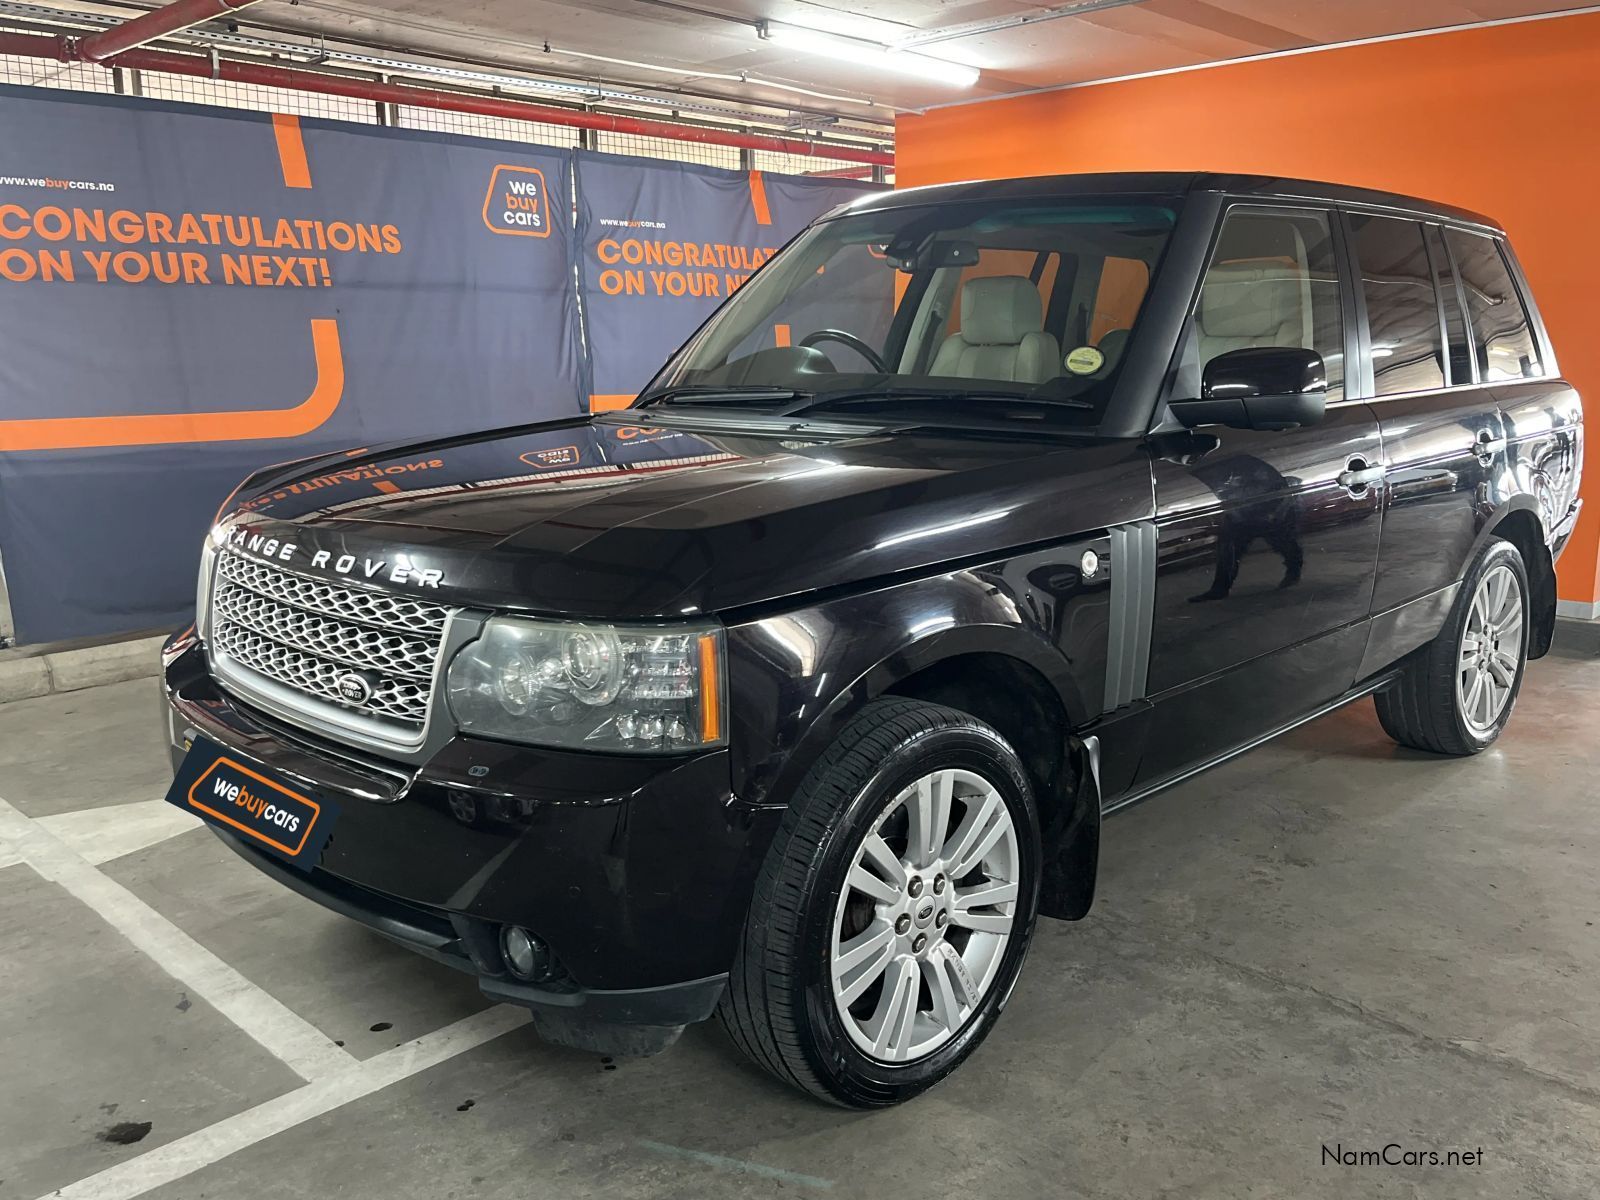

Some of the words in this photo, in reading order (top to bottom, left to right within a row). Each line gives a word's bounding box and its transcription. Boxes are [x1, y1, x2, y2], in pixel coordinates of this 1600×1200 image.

[505, 192, 537, 213] buy
[508, 180, 537, 196] we
[0, 204, 402, 254] CONGRATULATIONS
[503, 211, 541, 227] cars
[0, 248, 75, 282] ON
[82, 251, 211, 284] YOUR
[220, 254, 332, 287] NEXT!
[597, 239, 779, 270] CONGRATULAT
[600, 270, 646, 295] ON
[650, 271, 720, 297] YOUR
[227, 525, 298, 561] RANGE
[311, 550, 444, 589] ROVER
